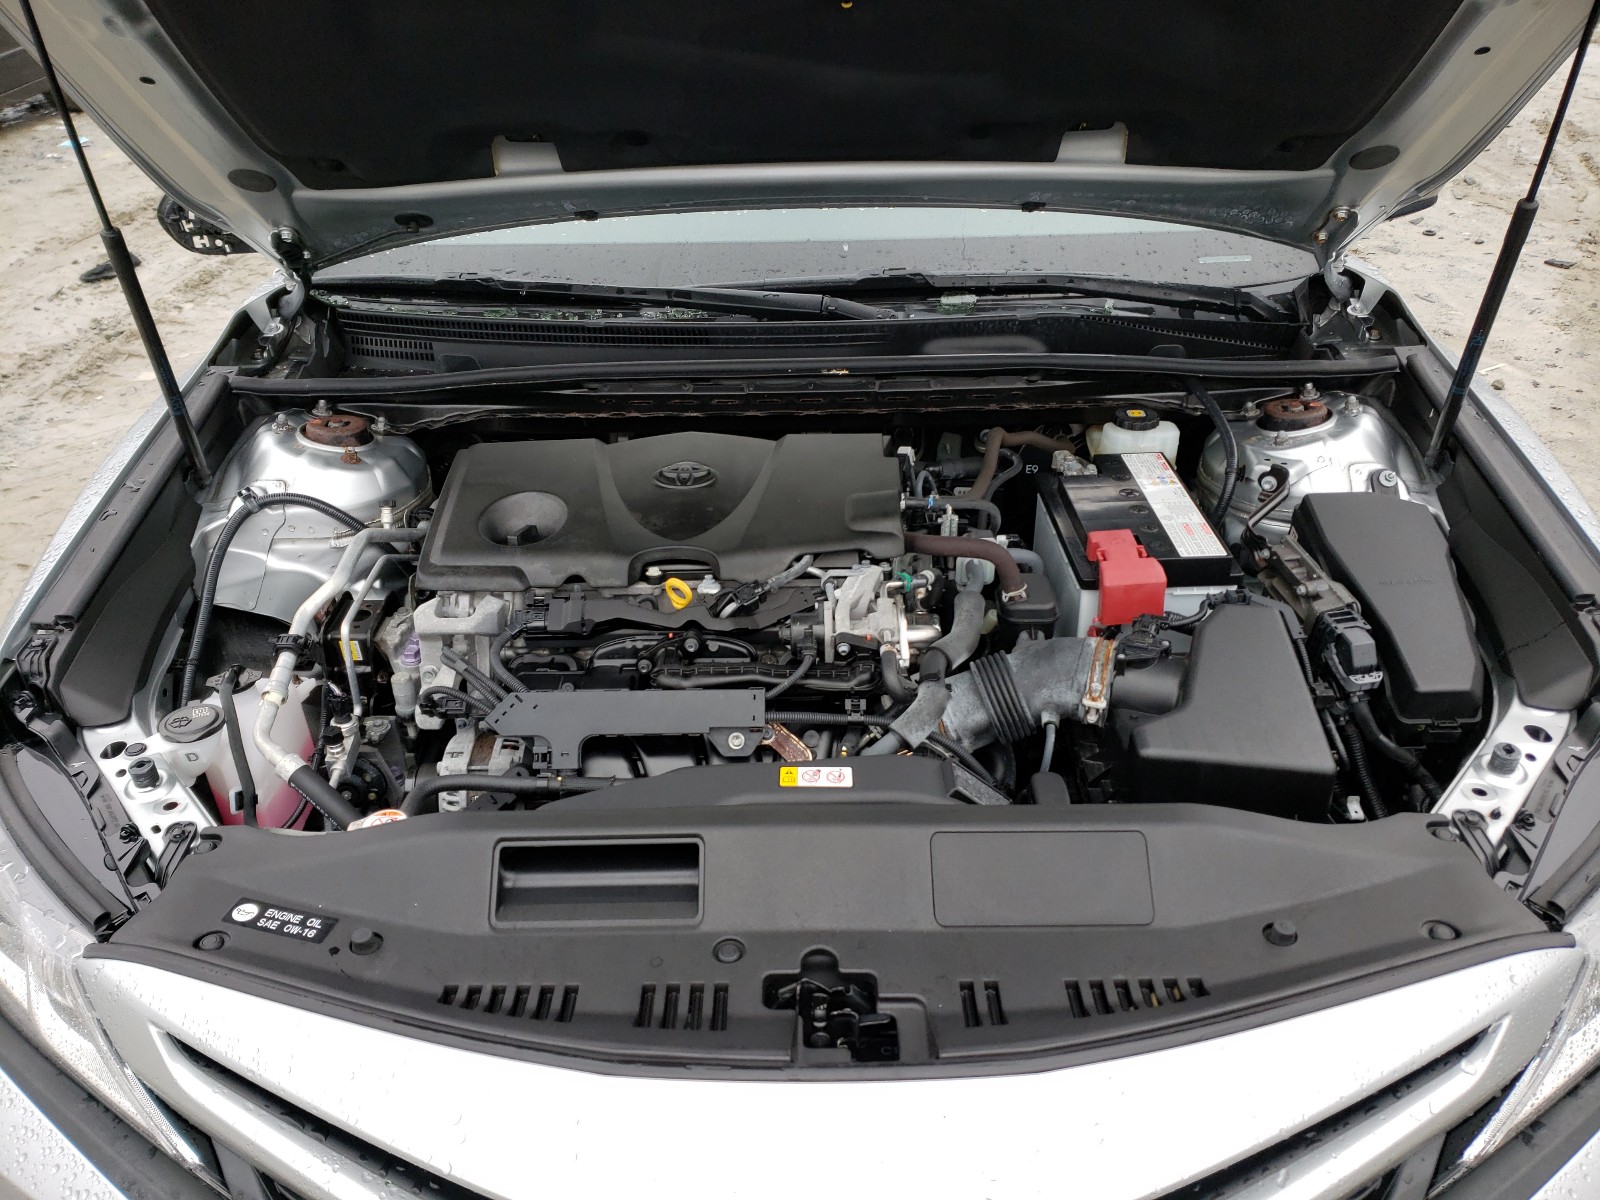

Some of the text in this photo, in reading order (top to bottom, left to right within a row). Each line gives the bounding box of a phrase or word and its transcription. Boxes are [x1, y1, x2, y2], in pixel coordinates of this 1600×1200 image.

[1025, 464, 1039, 474] E9
[256, 918, 317, 938] SAE 0W-16
[264, 908, 322, 929] ENGINE OIL
